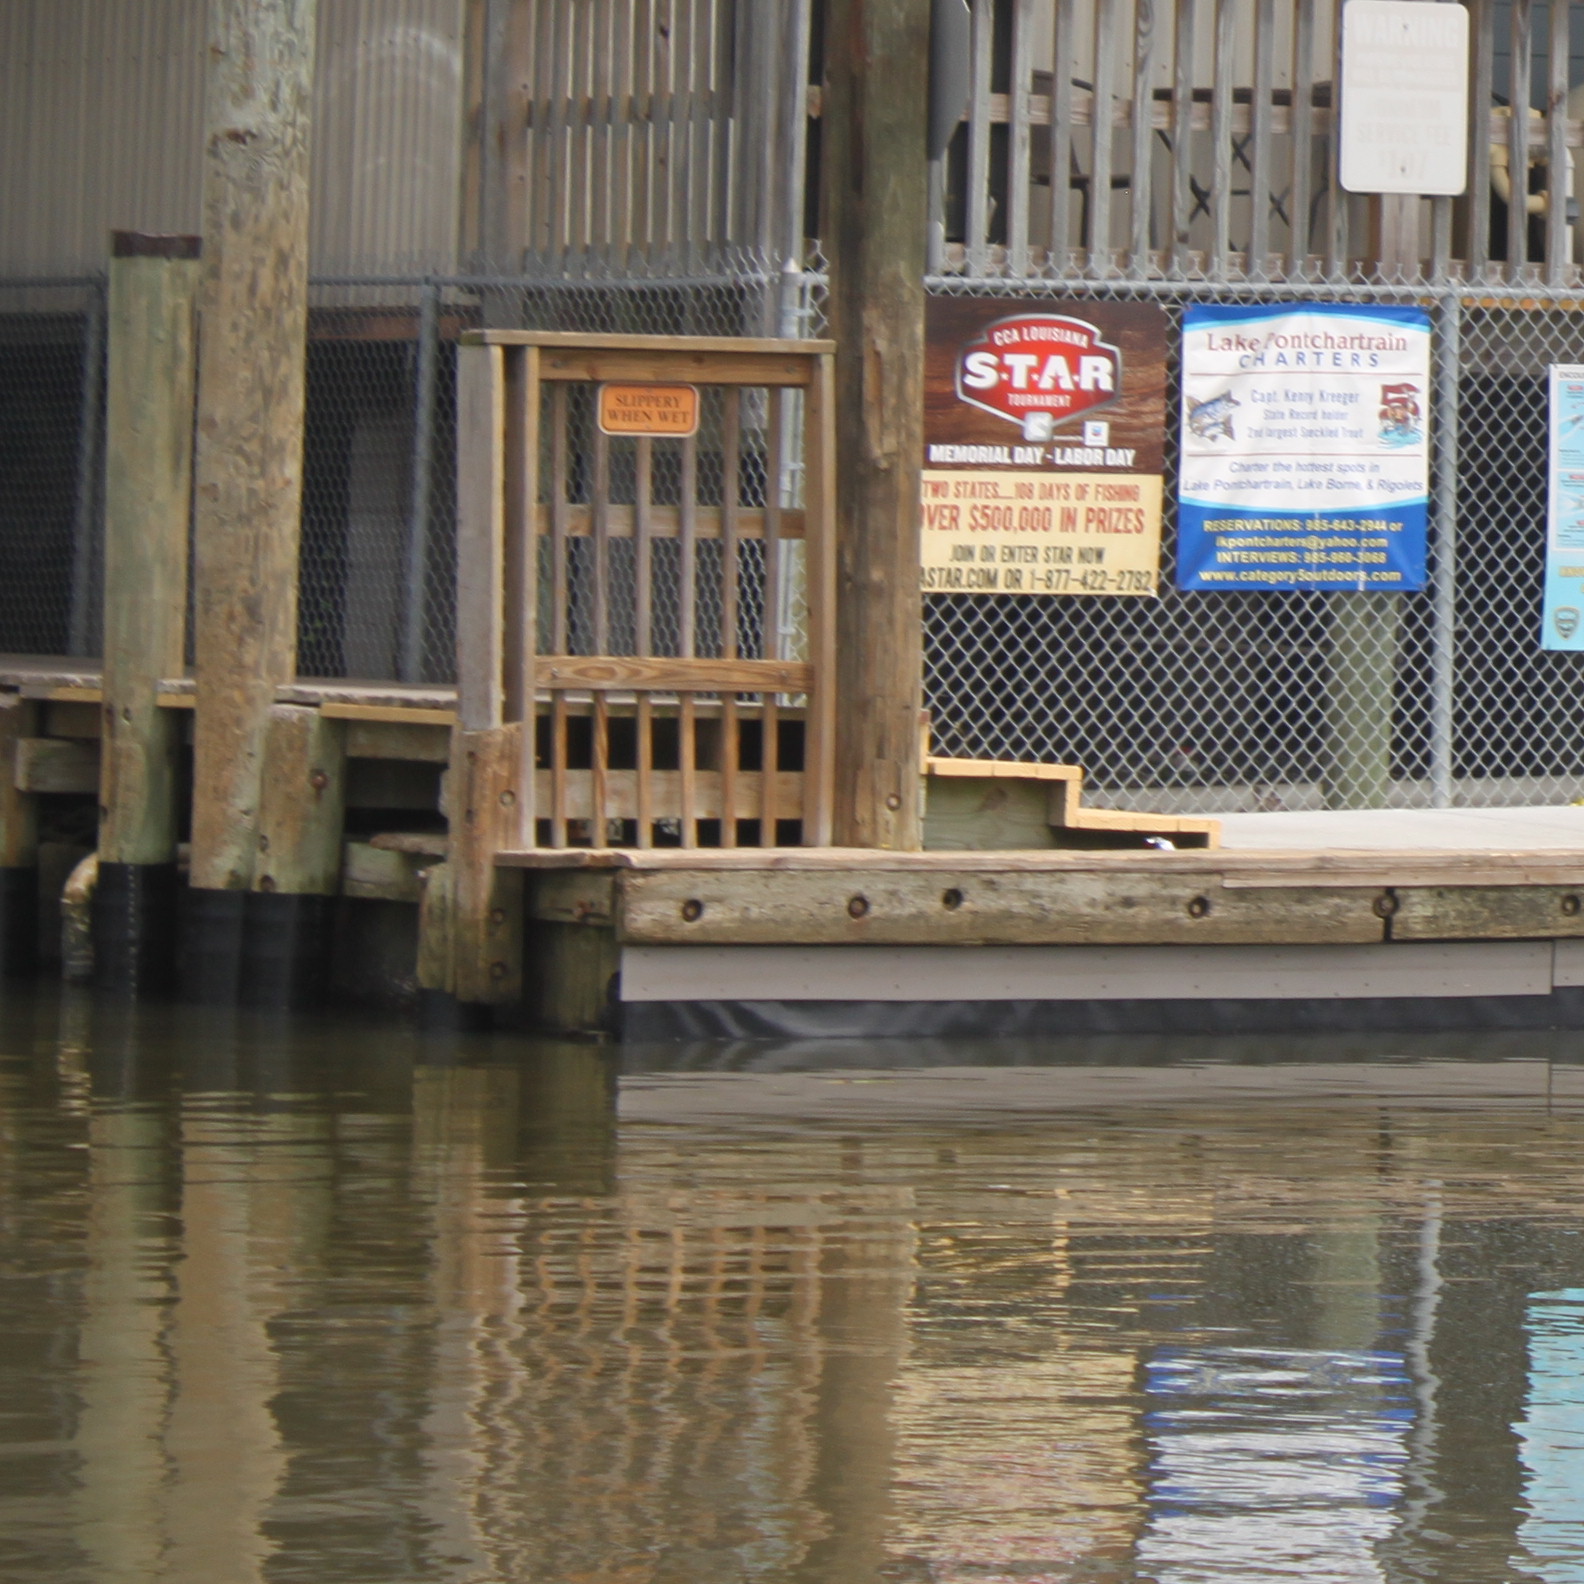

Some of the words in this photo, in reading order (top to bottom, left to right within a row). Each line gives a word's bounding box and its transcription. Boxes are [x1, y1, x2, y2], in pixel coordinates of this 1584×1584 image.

[1022, 326, 1089, 349] LOUISIANA
[1207, 333, 1260, 353] Lake
[1263, 332, 1408, 352] Pontchartrain
[1239, 352, 1379, 368] CHARTERS
[616, 394, 681, 408] SLIPPERY
[1007, 392, 1072, 408] TOURNAMENT
[1319, 390, 1360, 405] Kreeger
[607, 409, 652, 422] WHEN
[658, 411, 690, 424] WET
[929, 444, 1011, 465] MEMORIAL
[1013, 446, 1044, 465] DAY
[1055, 448, 1104, 466] LABOR
[1105, 448, 1136, 467] DAY
[1272, 461, 1291, 474] the
[922, 480, 949, 498] TWO
[1039, 482, 1071, 501] DAYS
[1075, 483, 1090, 501] OF
[1094, 483, 1140, 502] FISHING
[1182, 479, 1210, 492] Lake
[1297, 479, 1323, 493] Lake
[968, 505, 1052, 534] $500,000
[1060, 507, 1077, 533] IN
[1085, 507, 1145, 534] PRIZES
[1203, 519, 1302, 533] RESERVATIONS:
[1389, 521, 1403, 533] or
[949, 544, 975, 563] JOIN
[981, 545, 996, 563] OR
[1001, 545, 1039, 564] ENTER
[1043, 546, 1073, 564] STAR
[1077, 547, 1105, 565] NOW
[1004, 569, 1023, 590] OR
[1029, 569, 1152, 591] 1-877-422-2782
